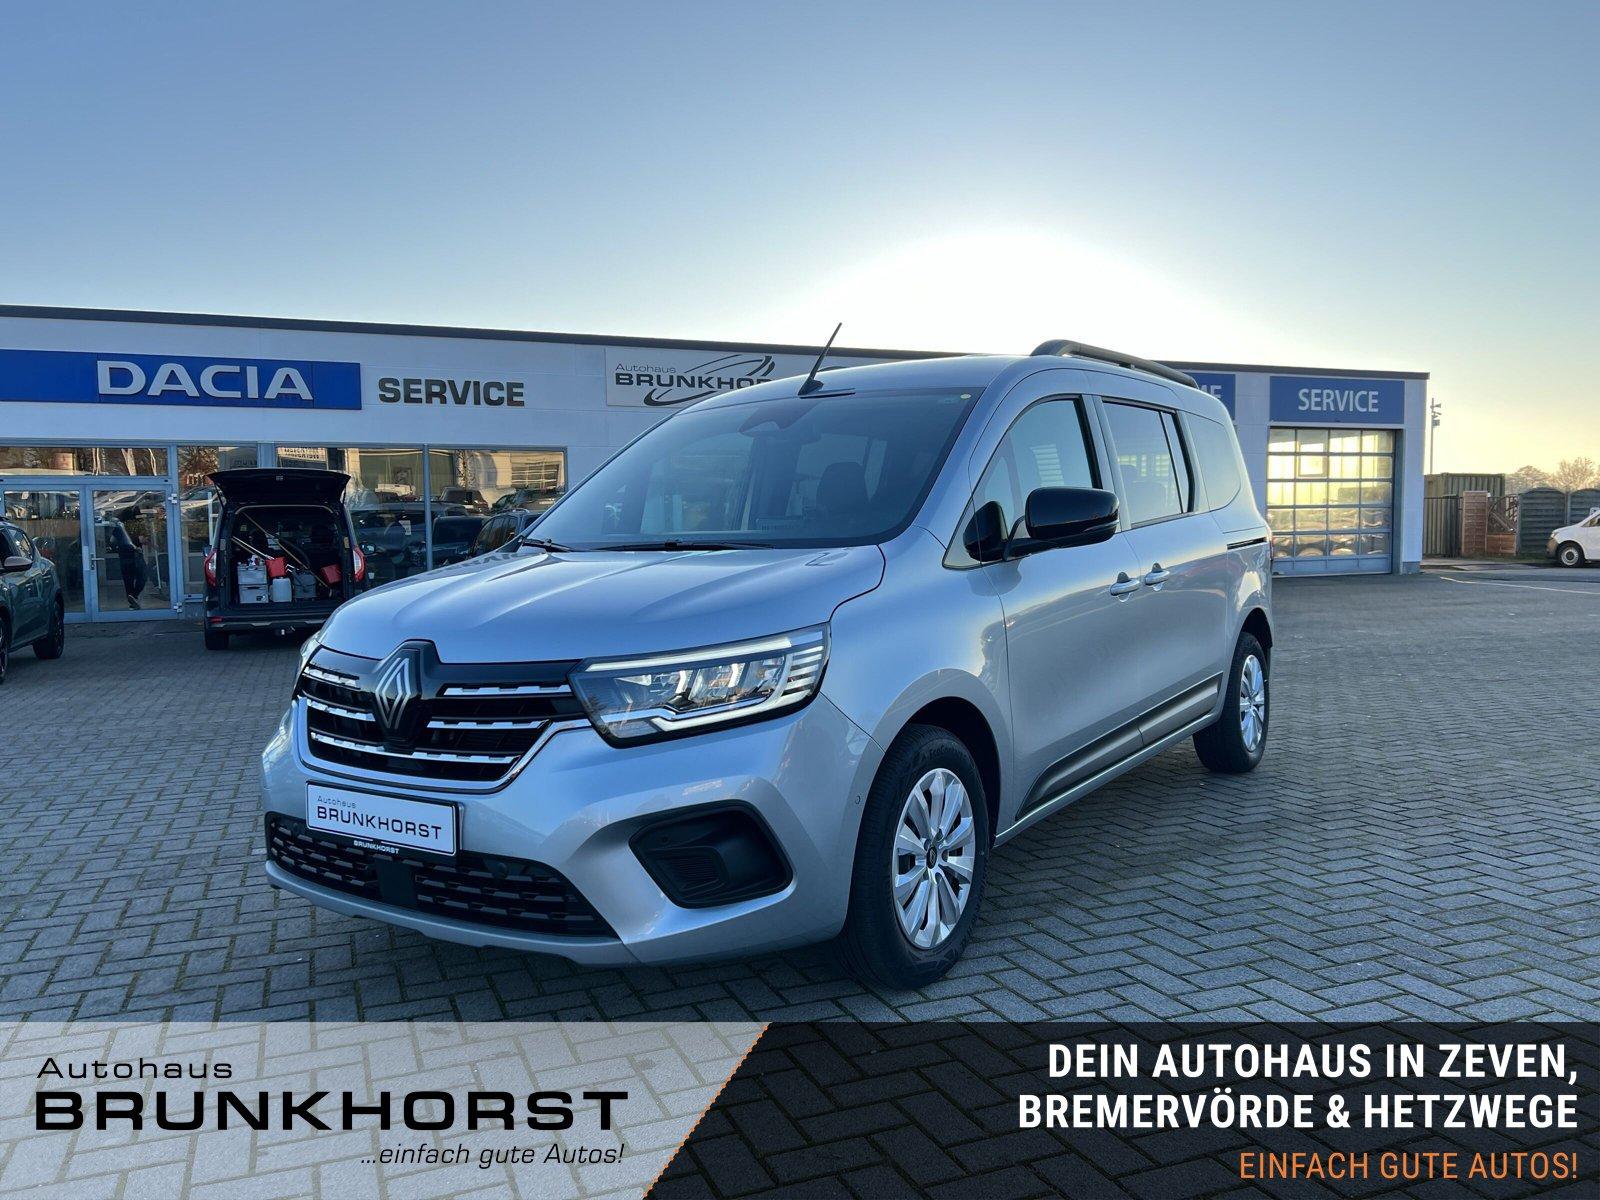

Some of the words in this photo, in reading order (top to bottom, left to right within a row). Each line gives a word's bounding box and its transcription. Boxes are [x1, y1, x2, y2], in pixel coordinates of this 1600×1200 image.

[97, 360, 313, 400] DACIA
[615, 363, 676, 374] Autohaus
[379, 377, 524, 407] SERVICE
[1297, 388, 1379, 413] SERVICE
[317, 795, 357, 808] Autohaus
[317, 805, 442, 840] BRUNKHORST
[353, 839, 400, 855] BRUNKHORST
